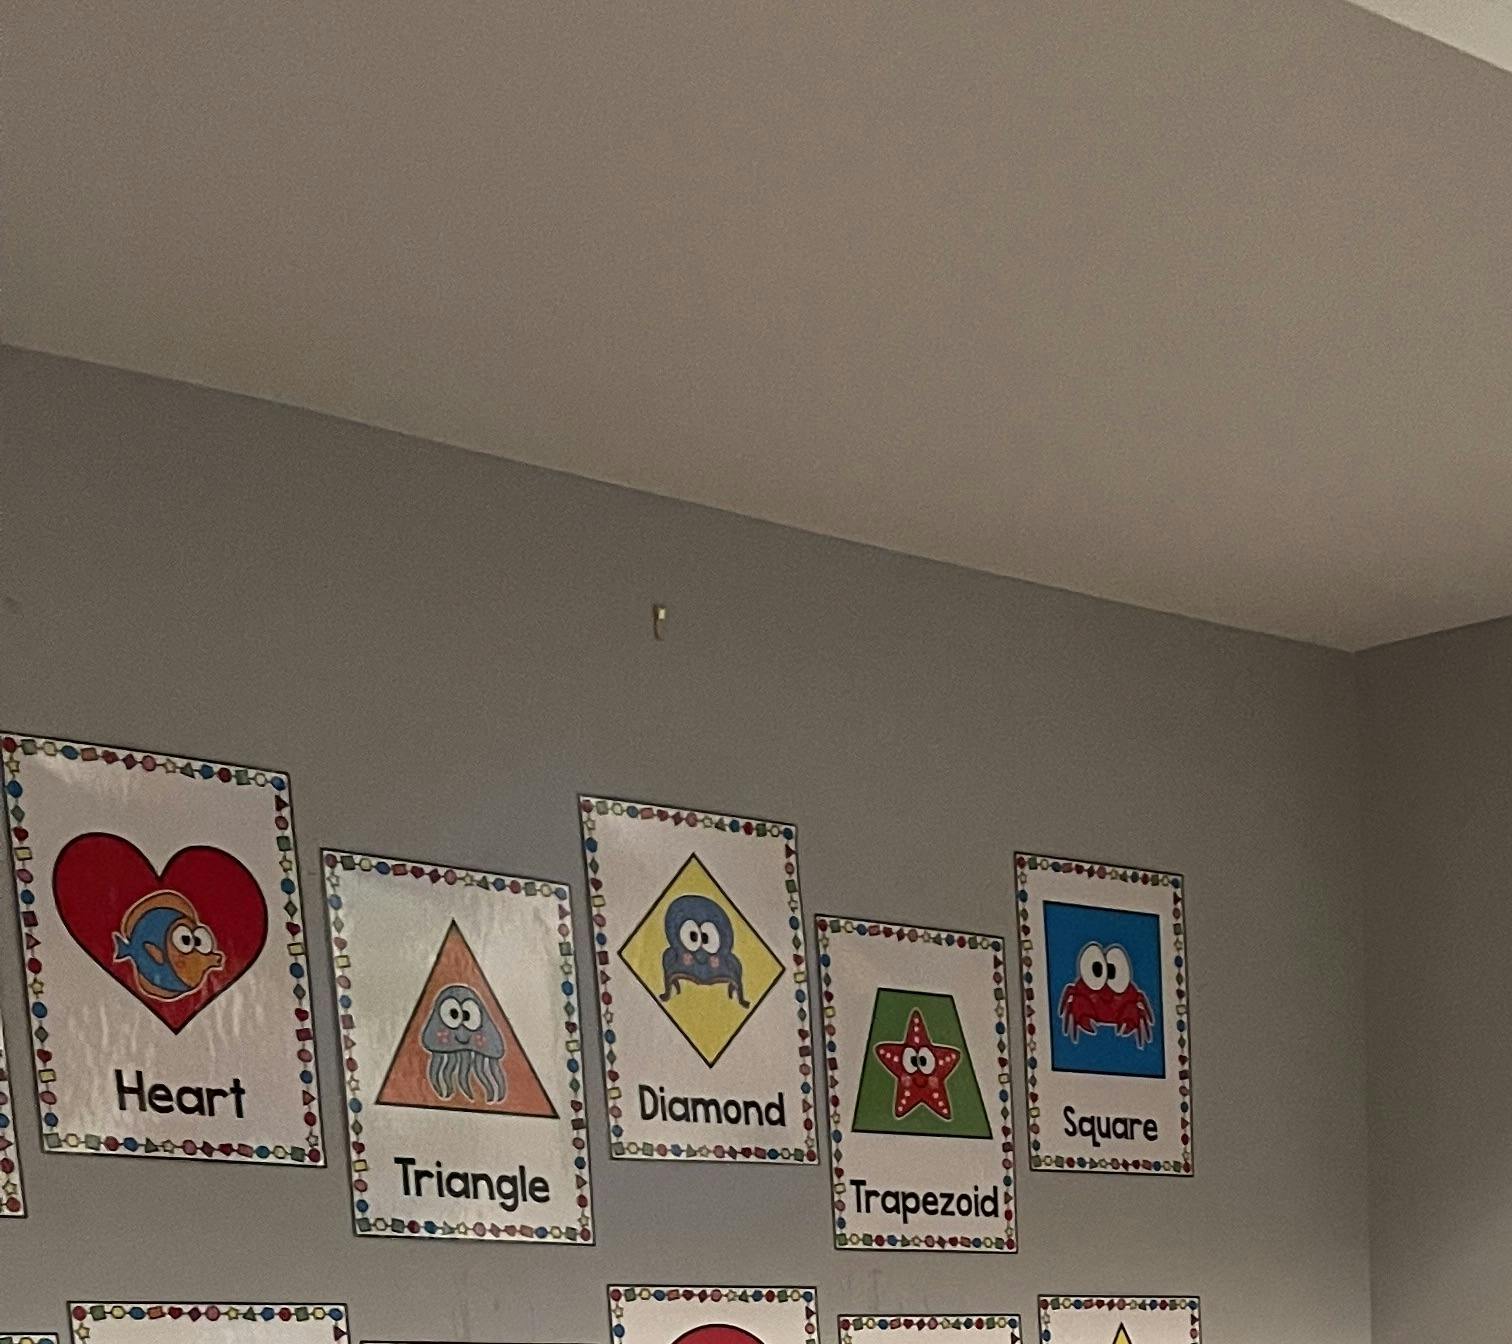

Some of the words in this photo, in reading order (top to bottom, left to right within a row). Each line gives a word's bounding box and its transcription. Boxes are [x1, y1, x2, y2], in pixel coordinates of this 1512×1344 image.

[114, 1068, 246, 1119] Heart
[638, 1084, 787, 1127] Diamond
[1063, 1105, 1159, 1148] Square
[393, 1157, 550, 1211] Triangle
[849, 1179, 999, 1225] Trapezoid
